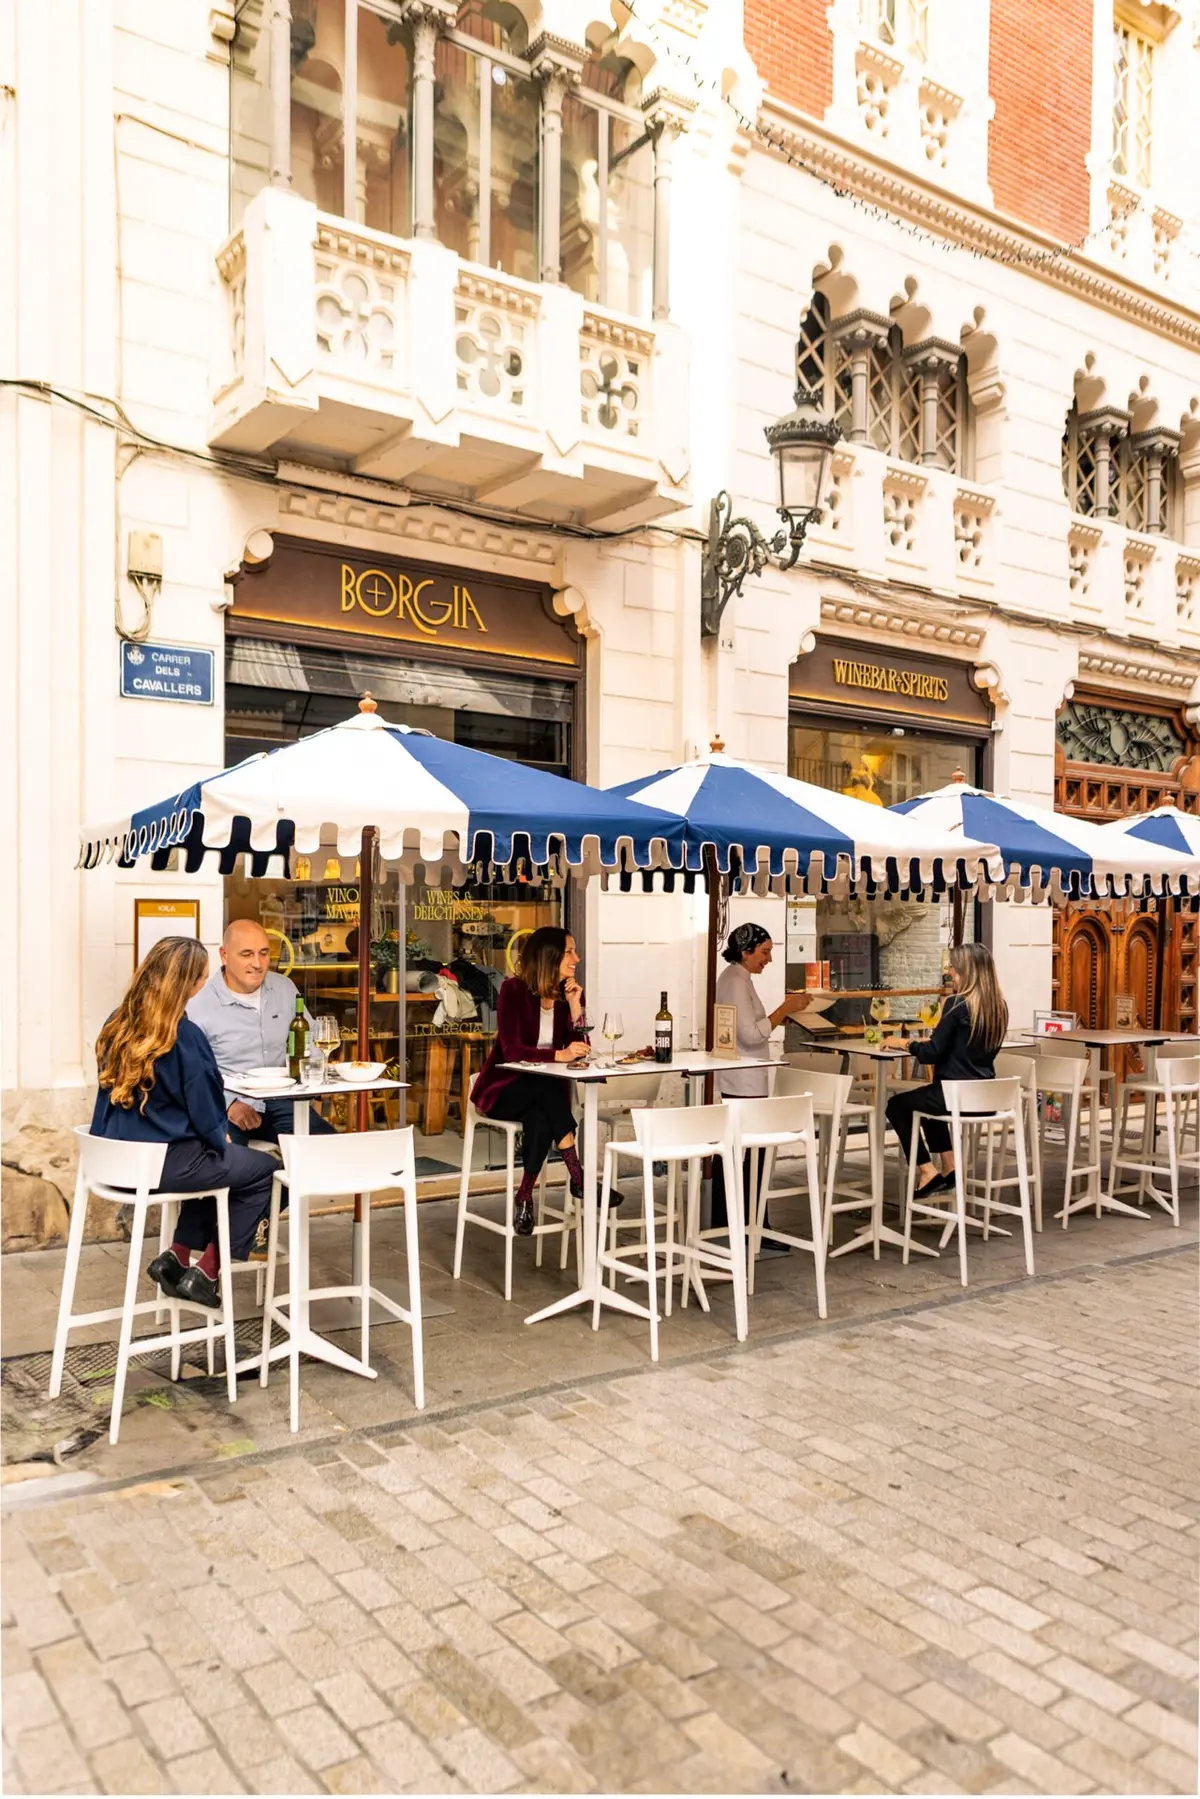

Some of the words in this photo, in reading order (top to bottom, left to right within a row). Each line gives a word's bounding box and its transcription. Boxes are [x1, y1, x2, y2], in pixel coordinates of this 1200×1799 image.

[340, 563, 488, 635] BORGIA
[151, 652, 191, 666] CARRER
[155, 665, 180, 677] DELS
[133, 677, 202, 696] CAVALLERS
[327, 887, 360, 903] VINO
[426, 890, 460, 905] WINES
[325, 903, 360, 920] MANJA
